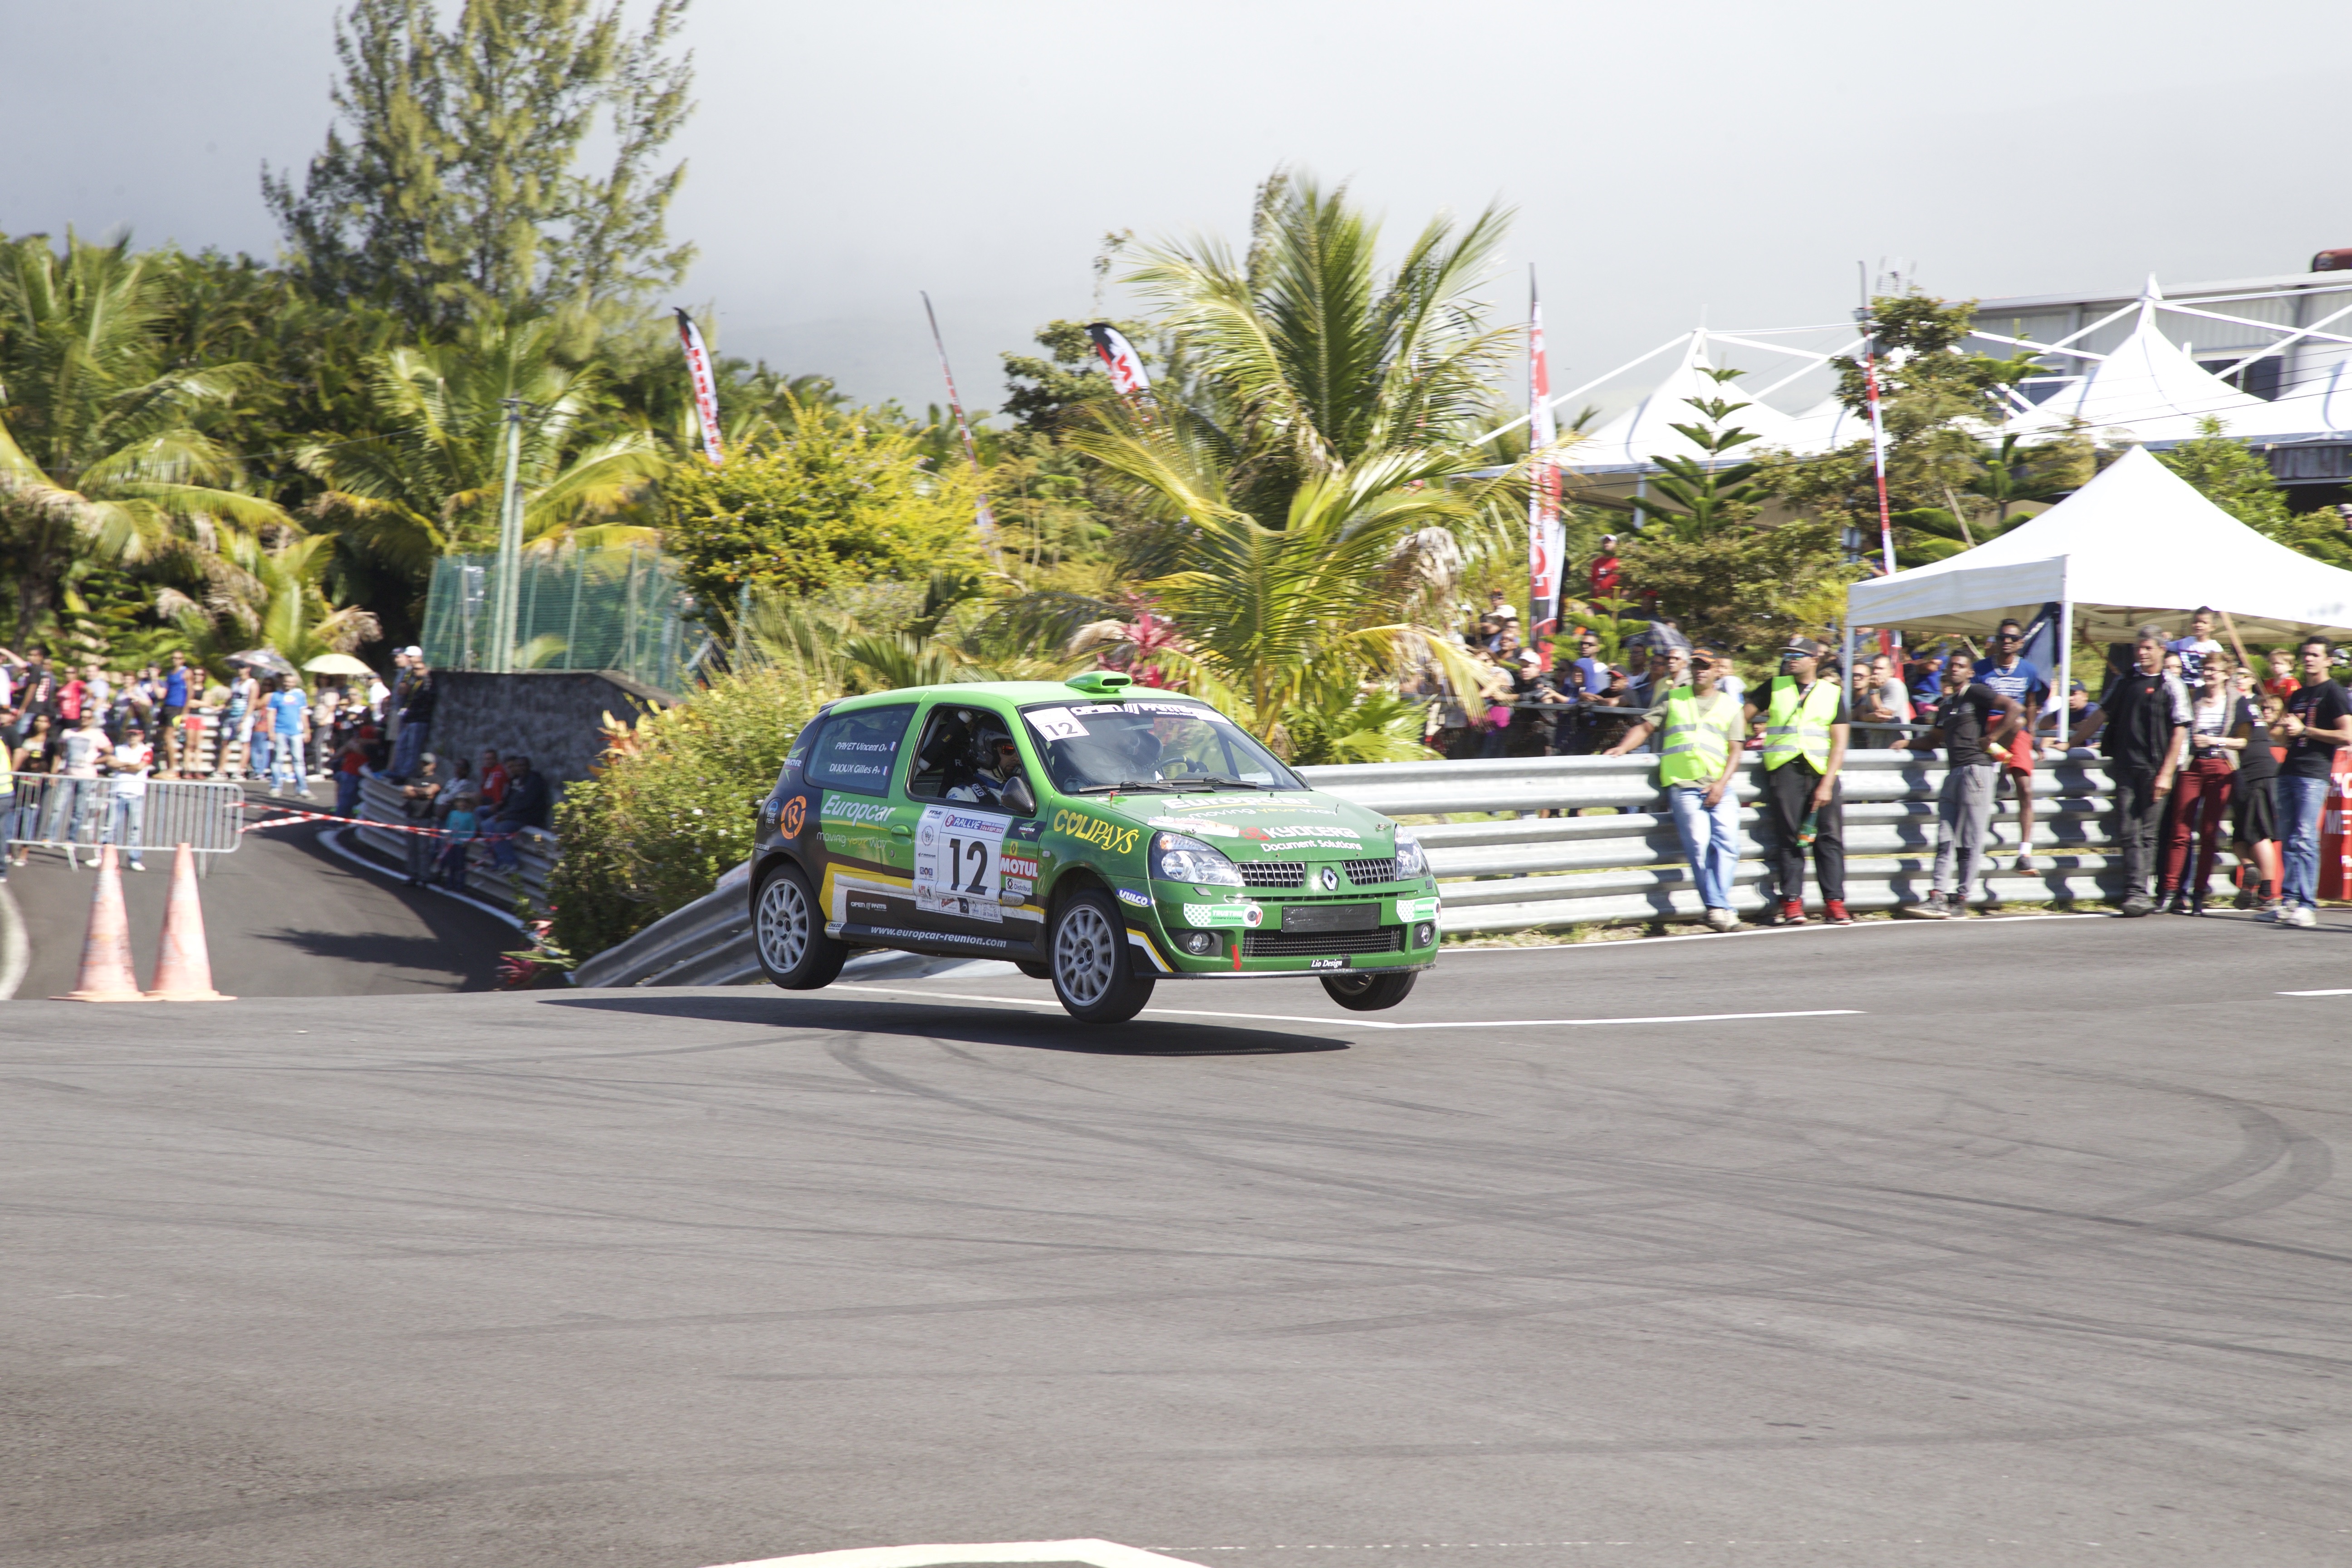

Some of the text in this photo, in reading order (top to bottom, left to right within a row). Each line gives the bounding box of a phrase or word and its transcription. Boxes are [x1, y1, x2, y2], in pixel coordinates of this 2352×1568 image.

[1045, 722, 1078, 736] 12
[835, 742, 857, 750] PAYET
[856, 743, 879, 751] Vincent
[829, 764, 854, 772] DIJOUX
[854, 764, 871, 774] Gilles
[1161, 797, 1311, 809] Europcar
[821, 795, 897, 826] Europcar
[1189, 808, 1256, 820] moving
[953, 818, 981, 829] RALLYE
[1054, 809, 1139, 854] COLIPAYS
[1262, 826, 1361, 838] KYOCERA
[817, 832, 887, 851] moving your way
[1260, 840, 1362, 852] Document Solutions
[949, 838, 988, 896] 12
[1000, 857, 1038, 877] MOTUL
[1119, 890, 1147, 906] VULCO
[871, 926, 1007, 948] www.europcar-reunion.com
[1311, 959, 1343, 969] Lio Design
